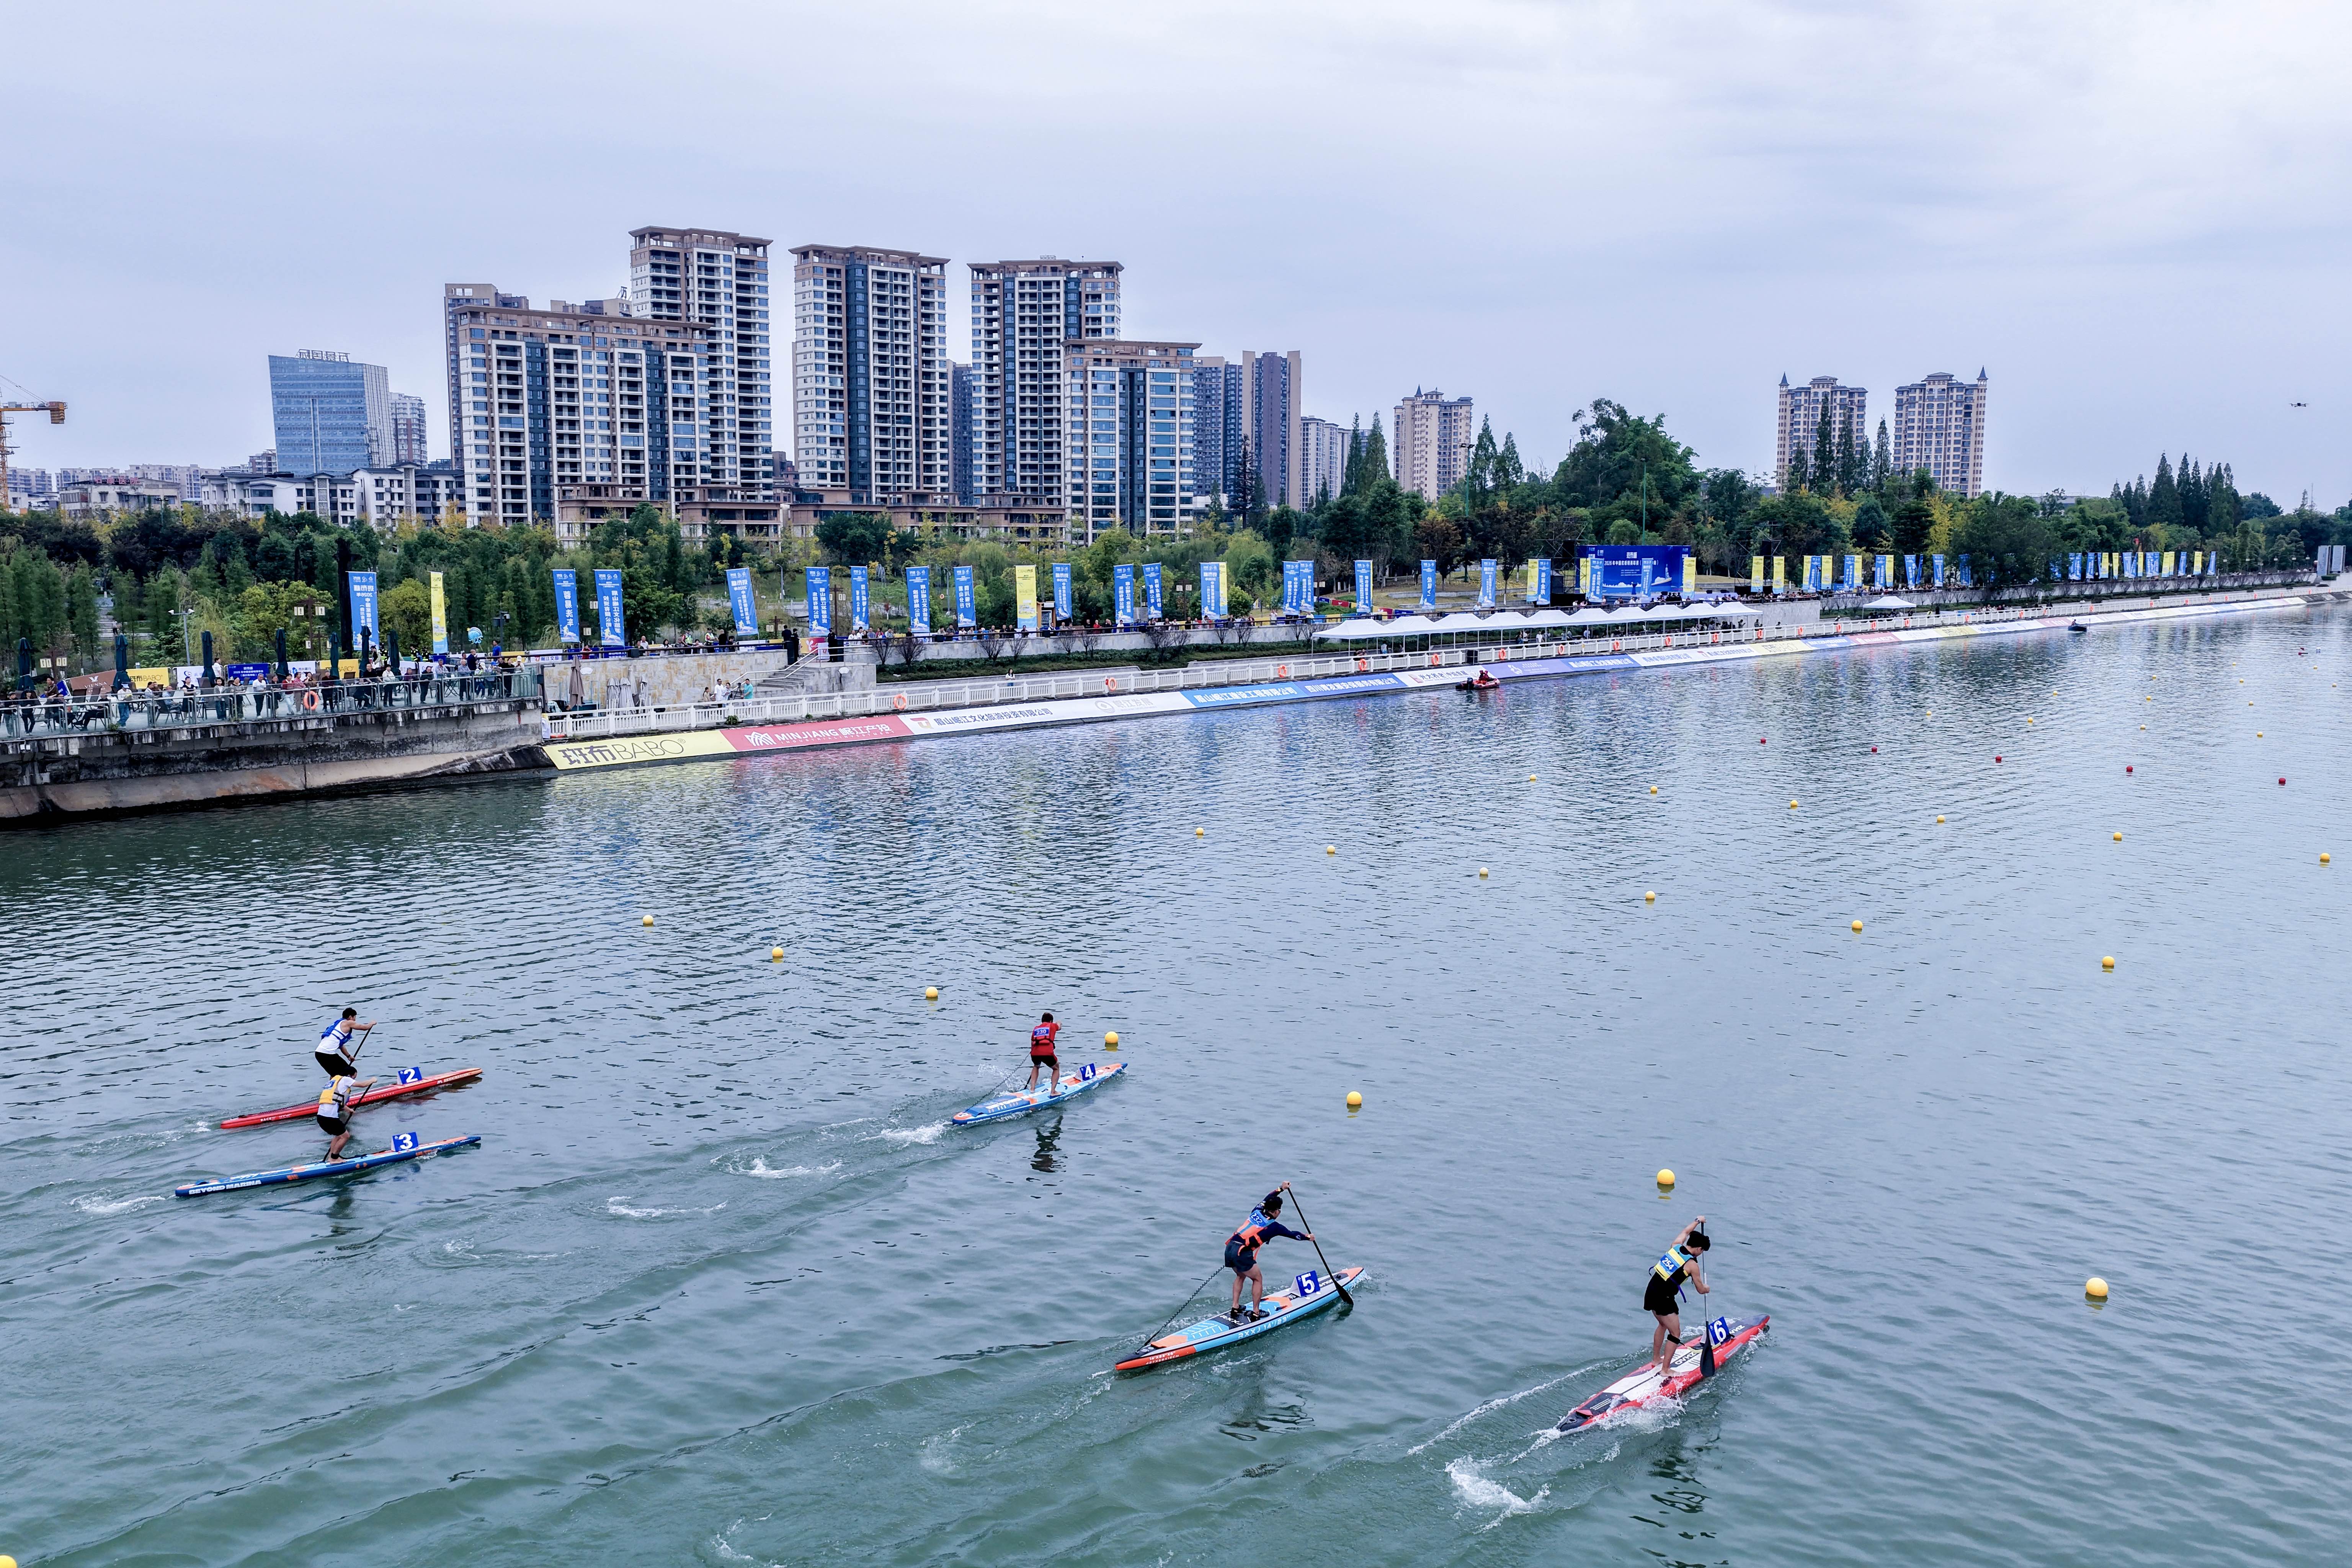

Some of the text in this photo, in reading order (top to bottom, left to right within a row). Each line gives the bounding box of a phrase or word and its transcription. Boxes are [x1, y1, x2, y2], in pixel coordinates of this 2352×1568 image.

[84, 681, 107, 689] VIENNA
[934, 708, 1053, 726] 眉山岷江文化旅游投资有限公司
[775, 724, 892, 741] MINJIANG 岷江产投
[403, 1068, 418, 1083] 2
[1085, 1065, 1094, 1079] 4
[399, 1134, 413, 1149] 3
[189, 1180, 262, 1195] BEYOND MARINA
[1251, 1213, 1263, 1225] 232
[1662, 1257, 1674, 1270] 254
[1301, 1273, 1315, 1294] 5
[1238, 1329, 1261, 1339] RXXJ
[1714, 1320, 1726, 1342] 6
